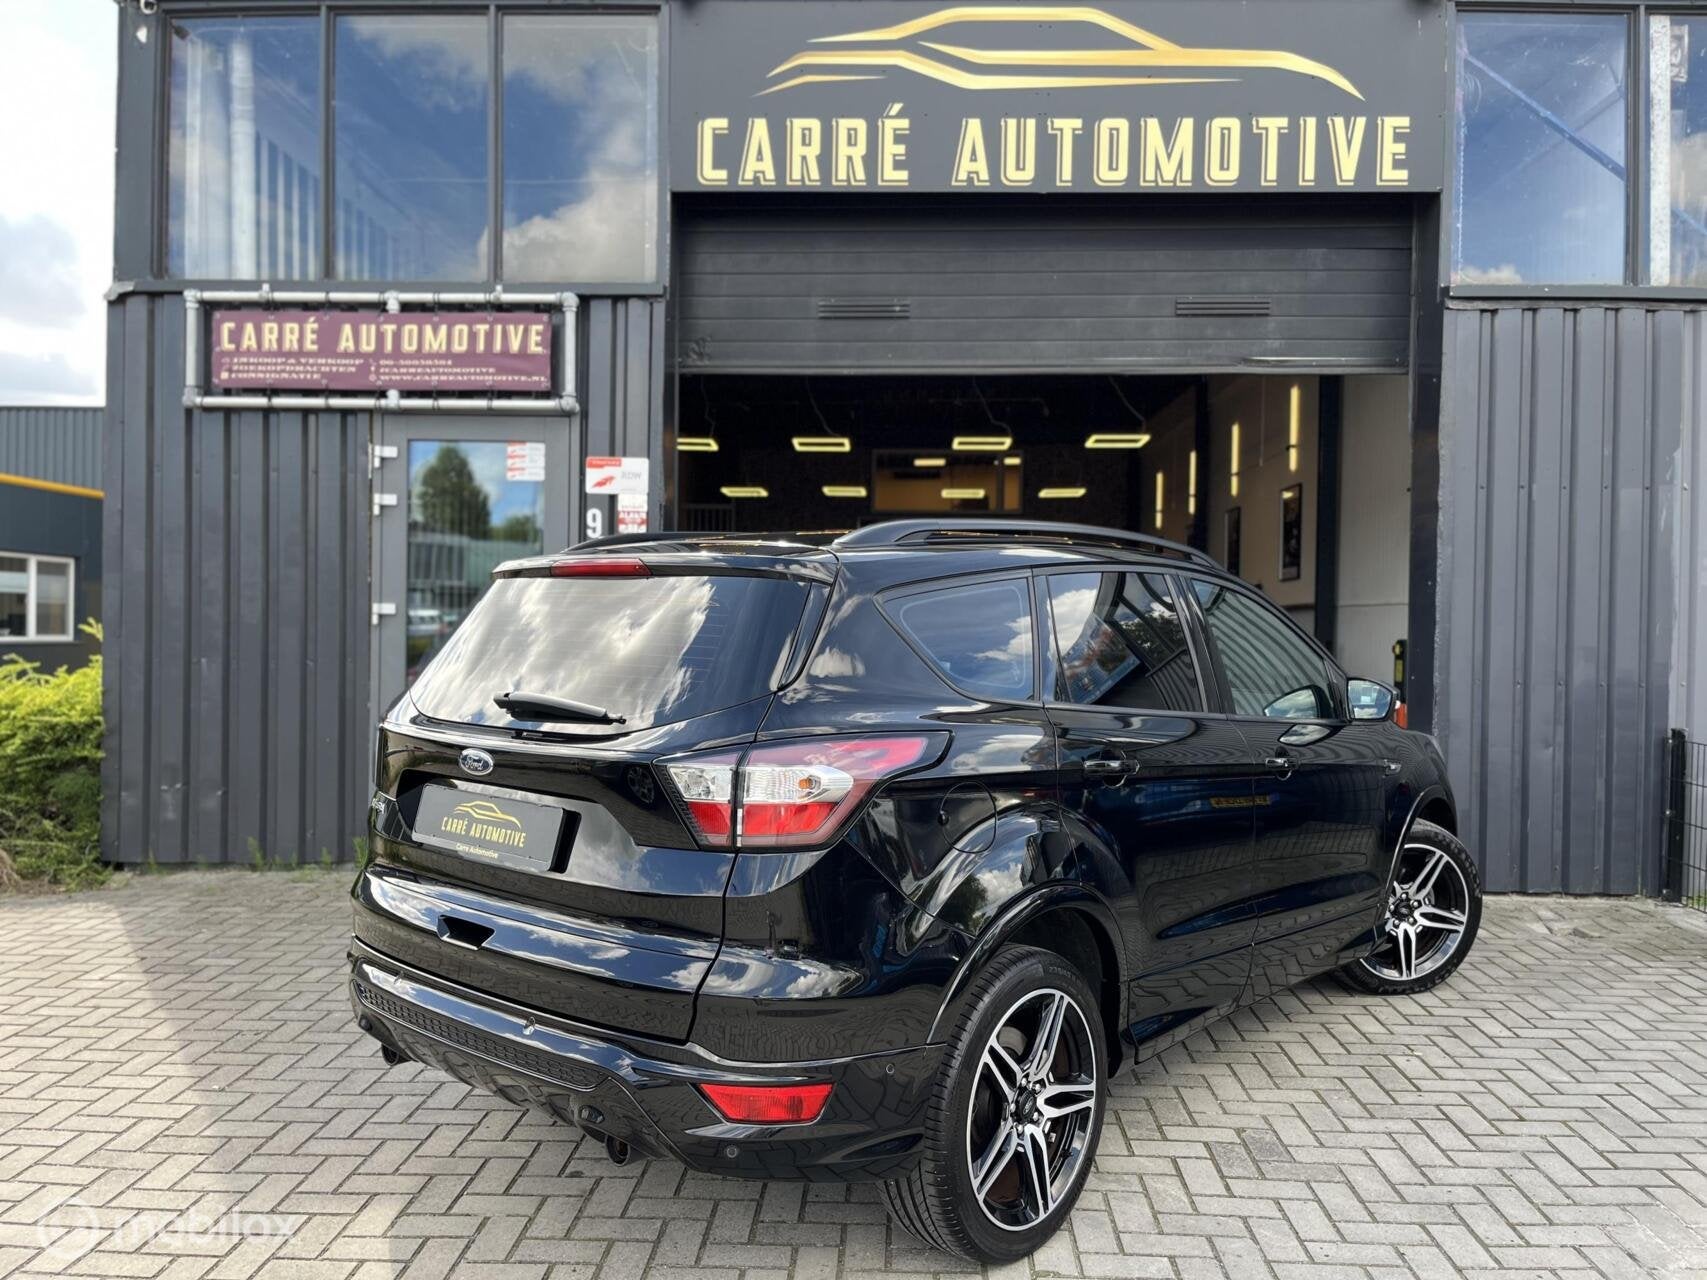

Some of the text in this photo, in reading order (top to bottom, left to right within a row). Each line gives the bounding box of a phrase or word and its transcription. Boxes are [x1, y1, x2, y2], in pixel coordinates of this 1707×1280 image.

[697, 103, 1411, 187] CARRÉ AUTOMOTIVE
[220, 316, 545, 354] CARRÉ AUTOMOTIVE
[585, 507, 602, 539] 9
[465, 754, 486, 772] Ford
[441, 816, 526, 847] CARRÉ AUTOMOTIVE
[469, 845, 499, 859] Automotive
